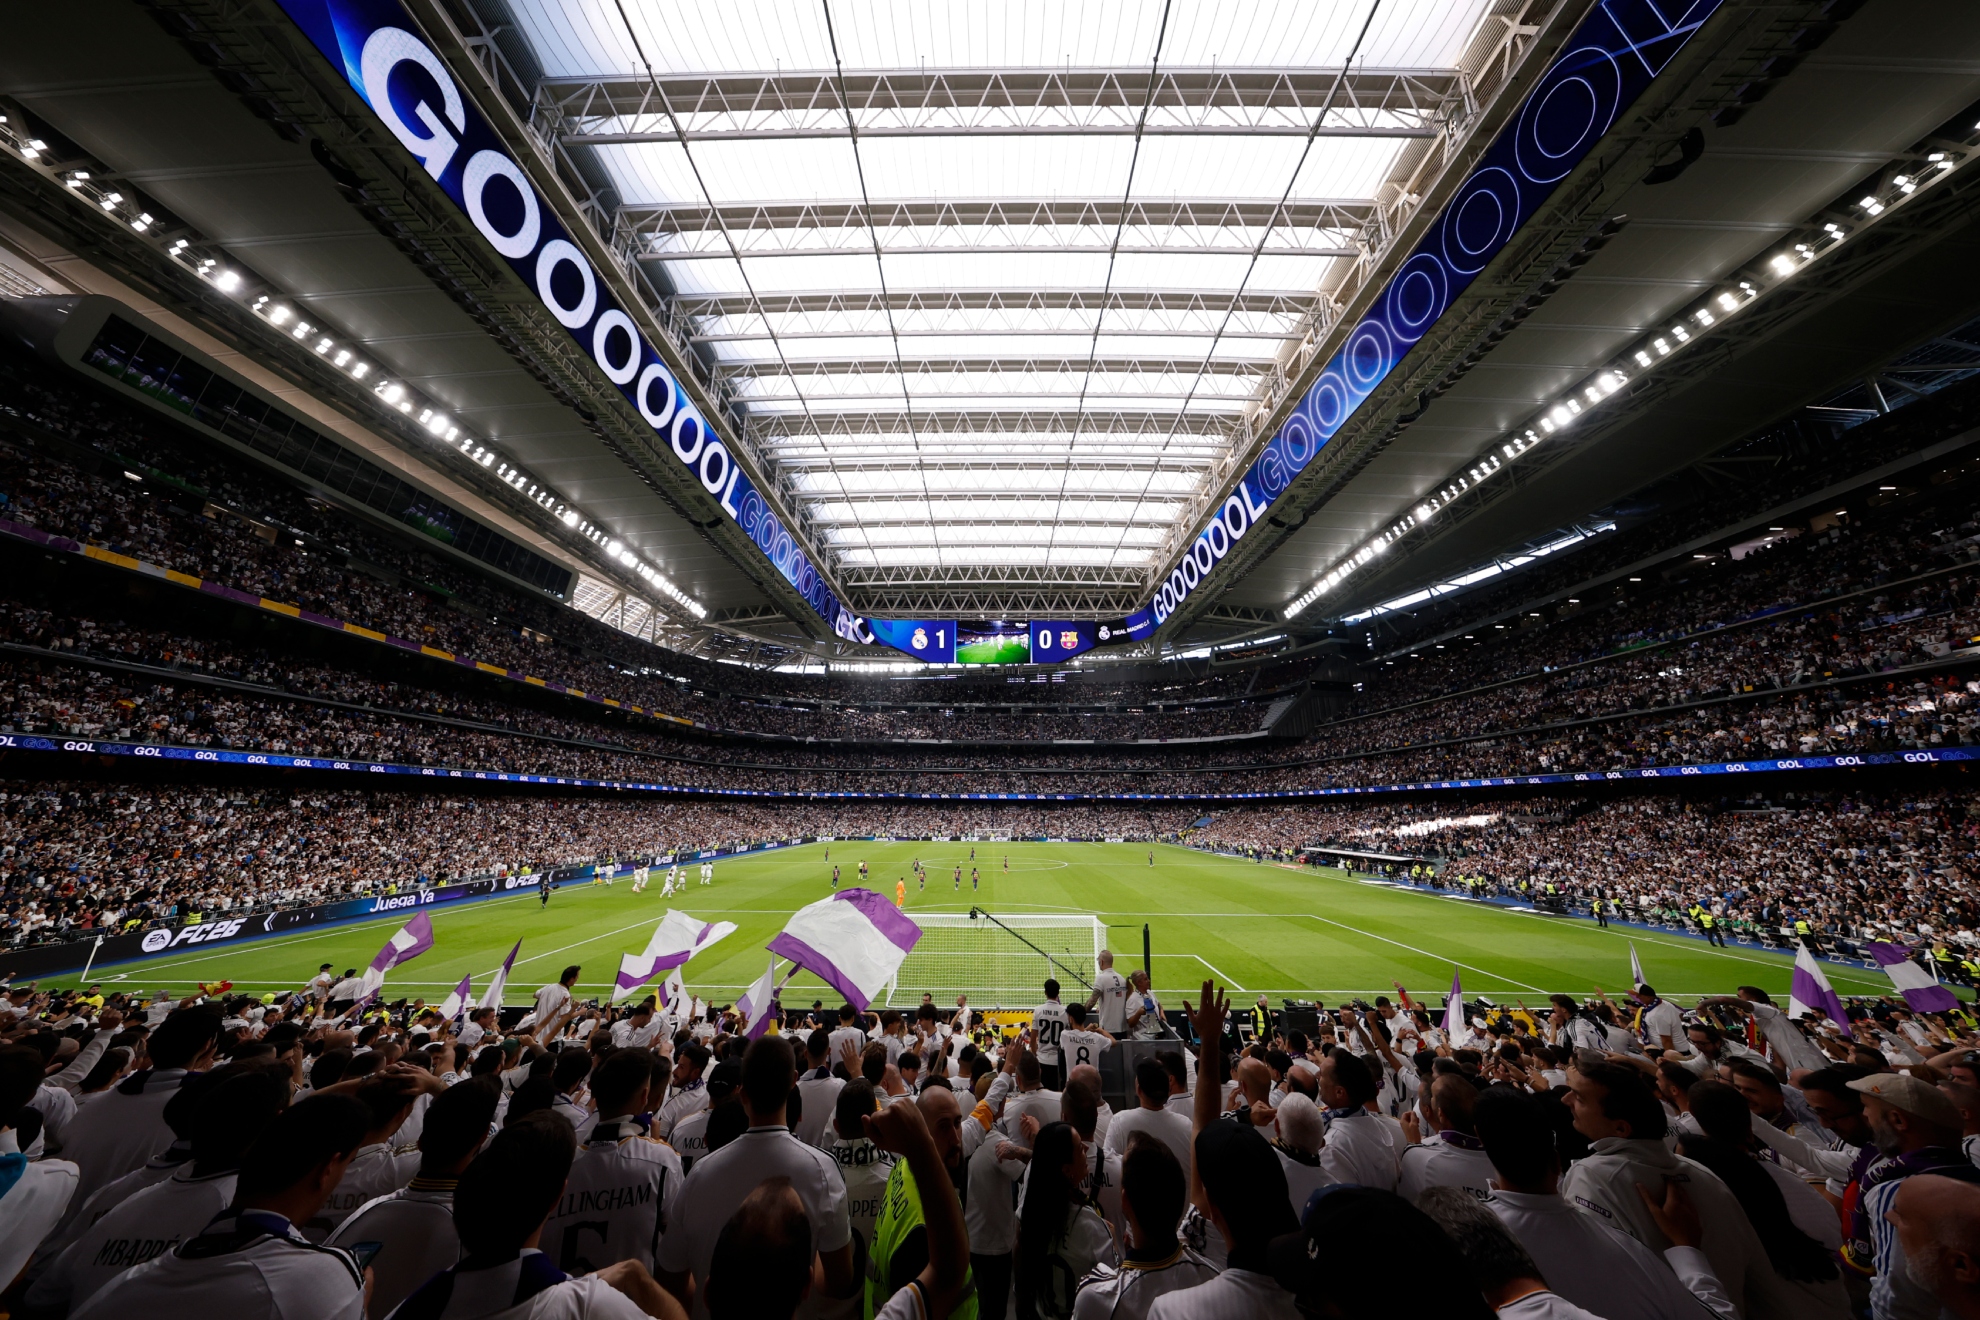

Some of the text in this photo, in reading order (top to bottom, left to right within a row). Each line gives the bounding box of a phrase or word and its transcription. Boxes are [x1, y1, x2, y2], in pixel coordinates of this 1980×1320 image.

[361, 26, 738, 520] GOOOOOOL
[1154, 481, 1267, 625] GOOOOOOL
[936, 631, 945, 649] 1
[1039, 630, 1052, 649] 0
[23, 738, 58, 750] GOL
[63, 741, 96, 752] GOL
[134, 746, 162, 757] GOL
[165, 749, 191, 758] GOL
[194, 751, 219, 761] GOL
[222, 752, 244, 762] GOL
[247, 755, 269, 764] GOL
[293, 758, 312, 767] GOL
[333, 762, 351, 770] GOL
[369, 765, 386, 773] GOL
[422, 768, 436, 776] GOL
[497, 773, 509, 781] GOL
[1574, 773, 1590, 781] GOL
[1606, 771, 1623, 779] GOL
[1641, 769, 1660, 777] GOL
[1681, 766, 1702, 775] GOL
[1702, 765, 1724, 774] GOL
[1725, 763, 1750, 772] GOL
[1751, 762, 1775, 771] GOL
[1777, 759, 1804, 769] GOL
[1804, 758, 1832, 768] GOL
[1835, 756, 1866, 766] GOL
[1869, 754, 1901, 764] GOL
[1904, 752, 1939, 763] GOL
[514, 872, 543, 887] FC26
[370, 889, 434, 912] Juega Ya
[149, 934, 166, 942] EA
[168, 918, 248, 947] FC26
[1113, 976, 1120, 986] 3
[670, 1022, 678, 1040] 7
[1039, 1019, 1064, 1046] 20
[1076, 1046, 1090, 1066] 8
[549, 1183, 651, 1220] LLINGHAM
